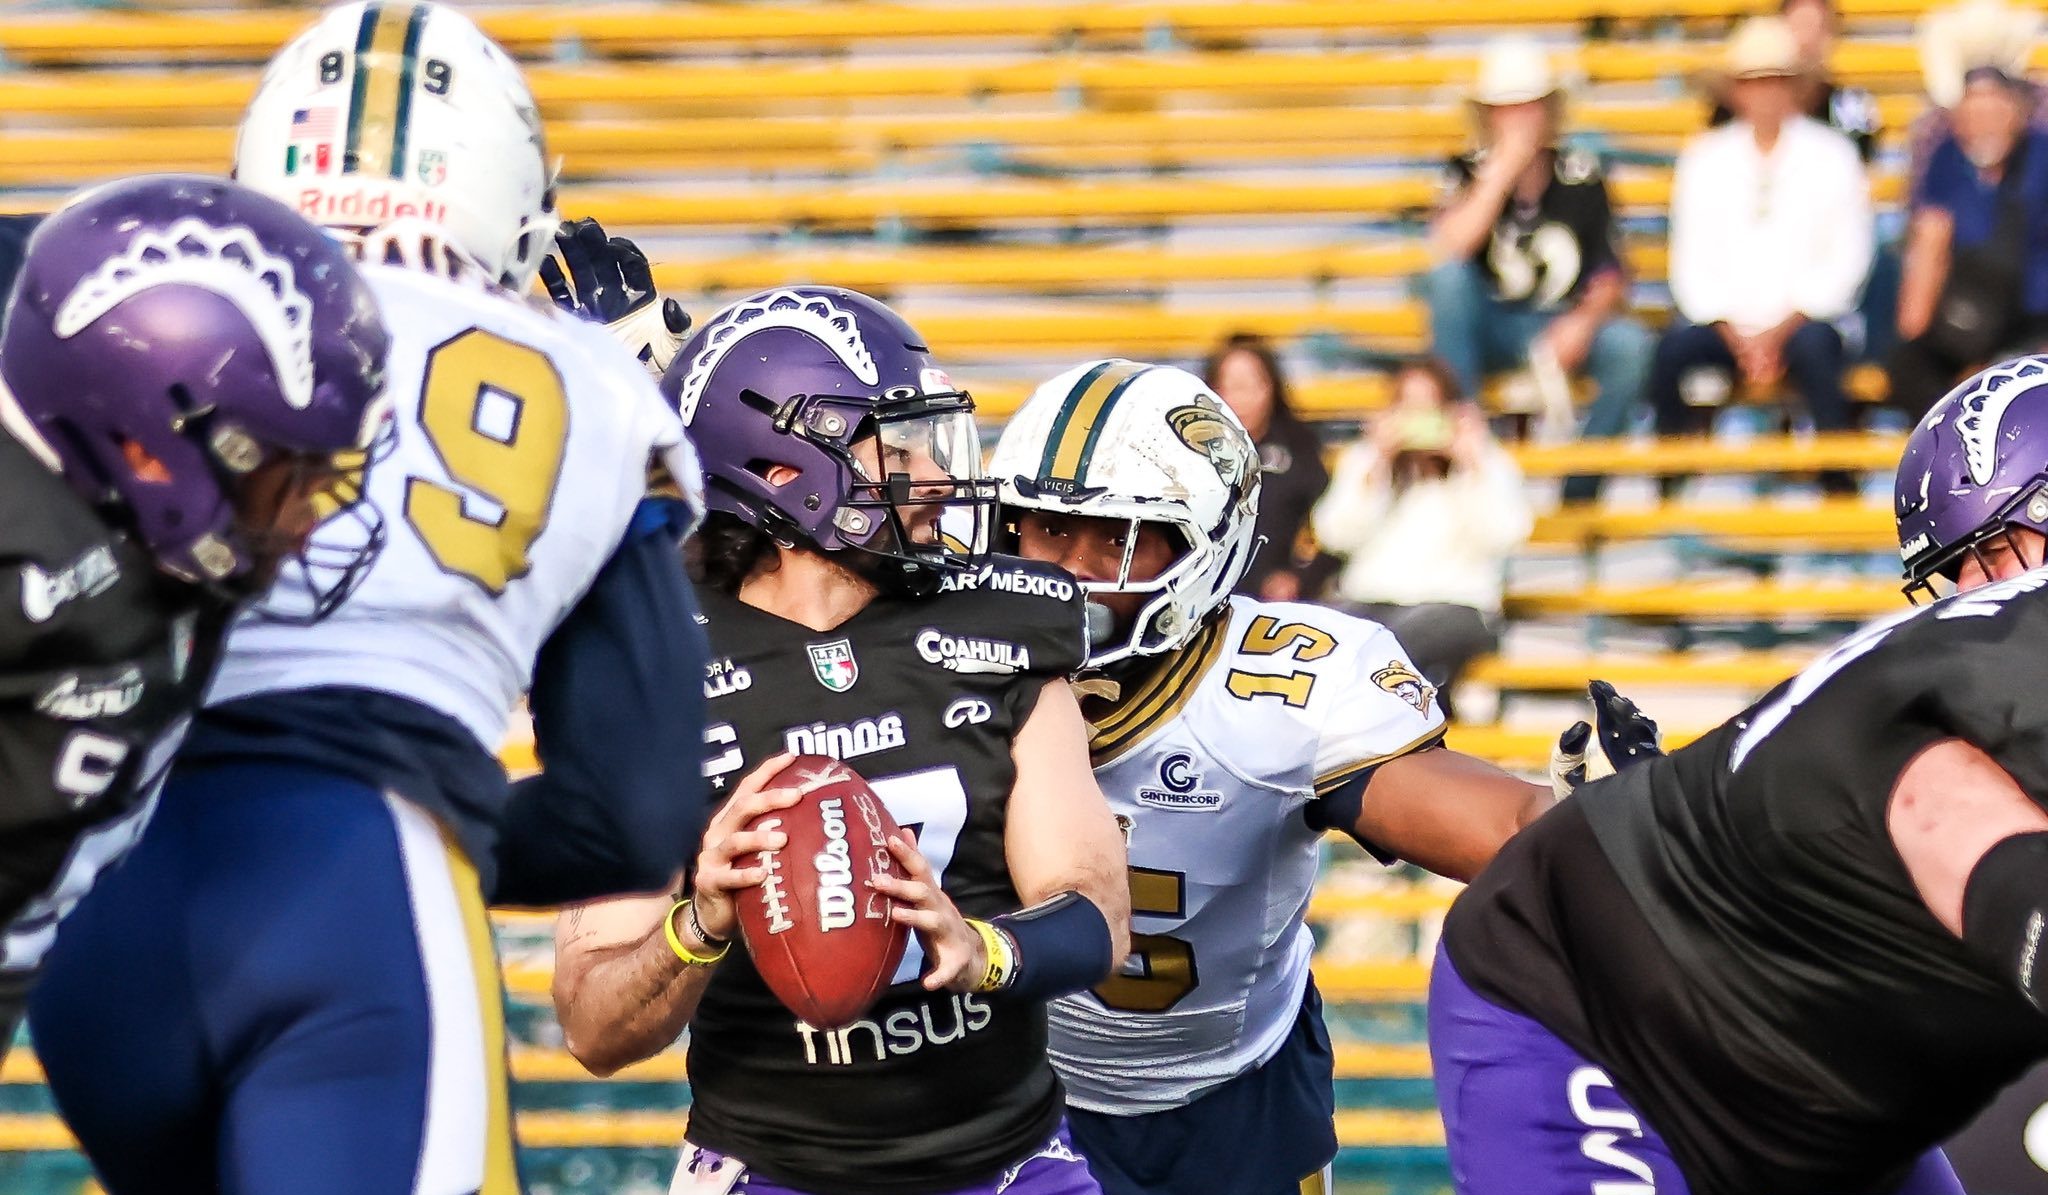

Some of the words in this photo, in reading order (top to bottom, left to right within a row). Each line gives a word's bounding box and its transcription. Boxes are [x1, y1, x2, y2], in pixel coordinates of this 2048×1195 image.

[320, 51, 344, 85] 8
[424, 59, 452, 95] 9
[299, 188, 446, 221] Riddell
[403, 325, 571, 598] 9
[1044, 480, 1074, 493] VICIS
[991, 570, 1074, 601] MÉXICO
[815, 647, 847, 660] LFA
[1225, 615, 1339, 709] 15
[1140, 791, 1220, 805] GINTHERCORP
[814, 797, 855, 933] Wilson
[796, 992, 991, 1064] finsus
